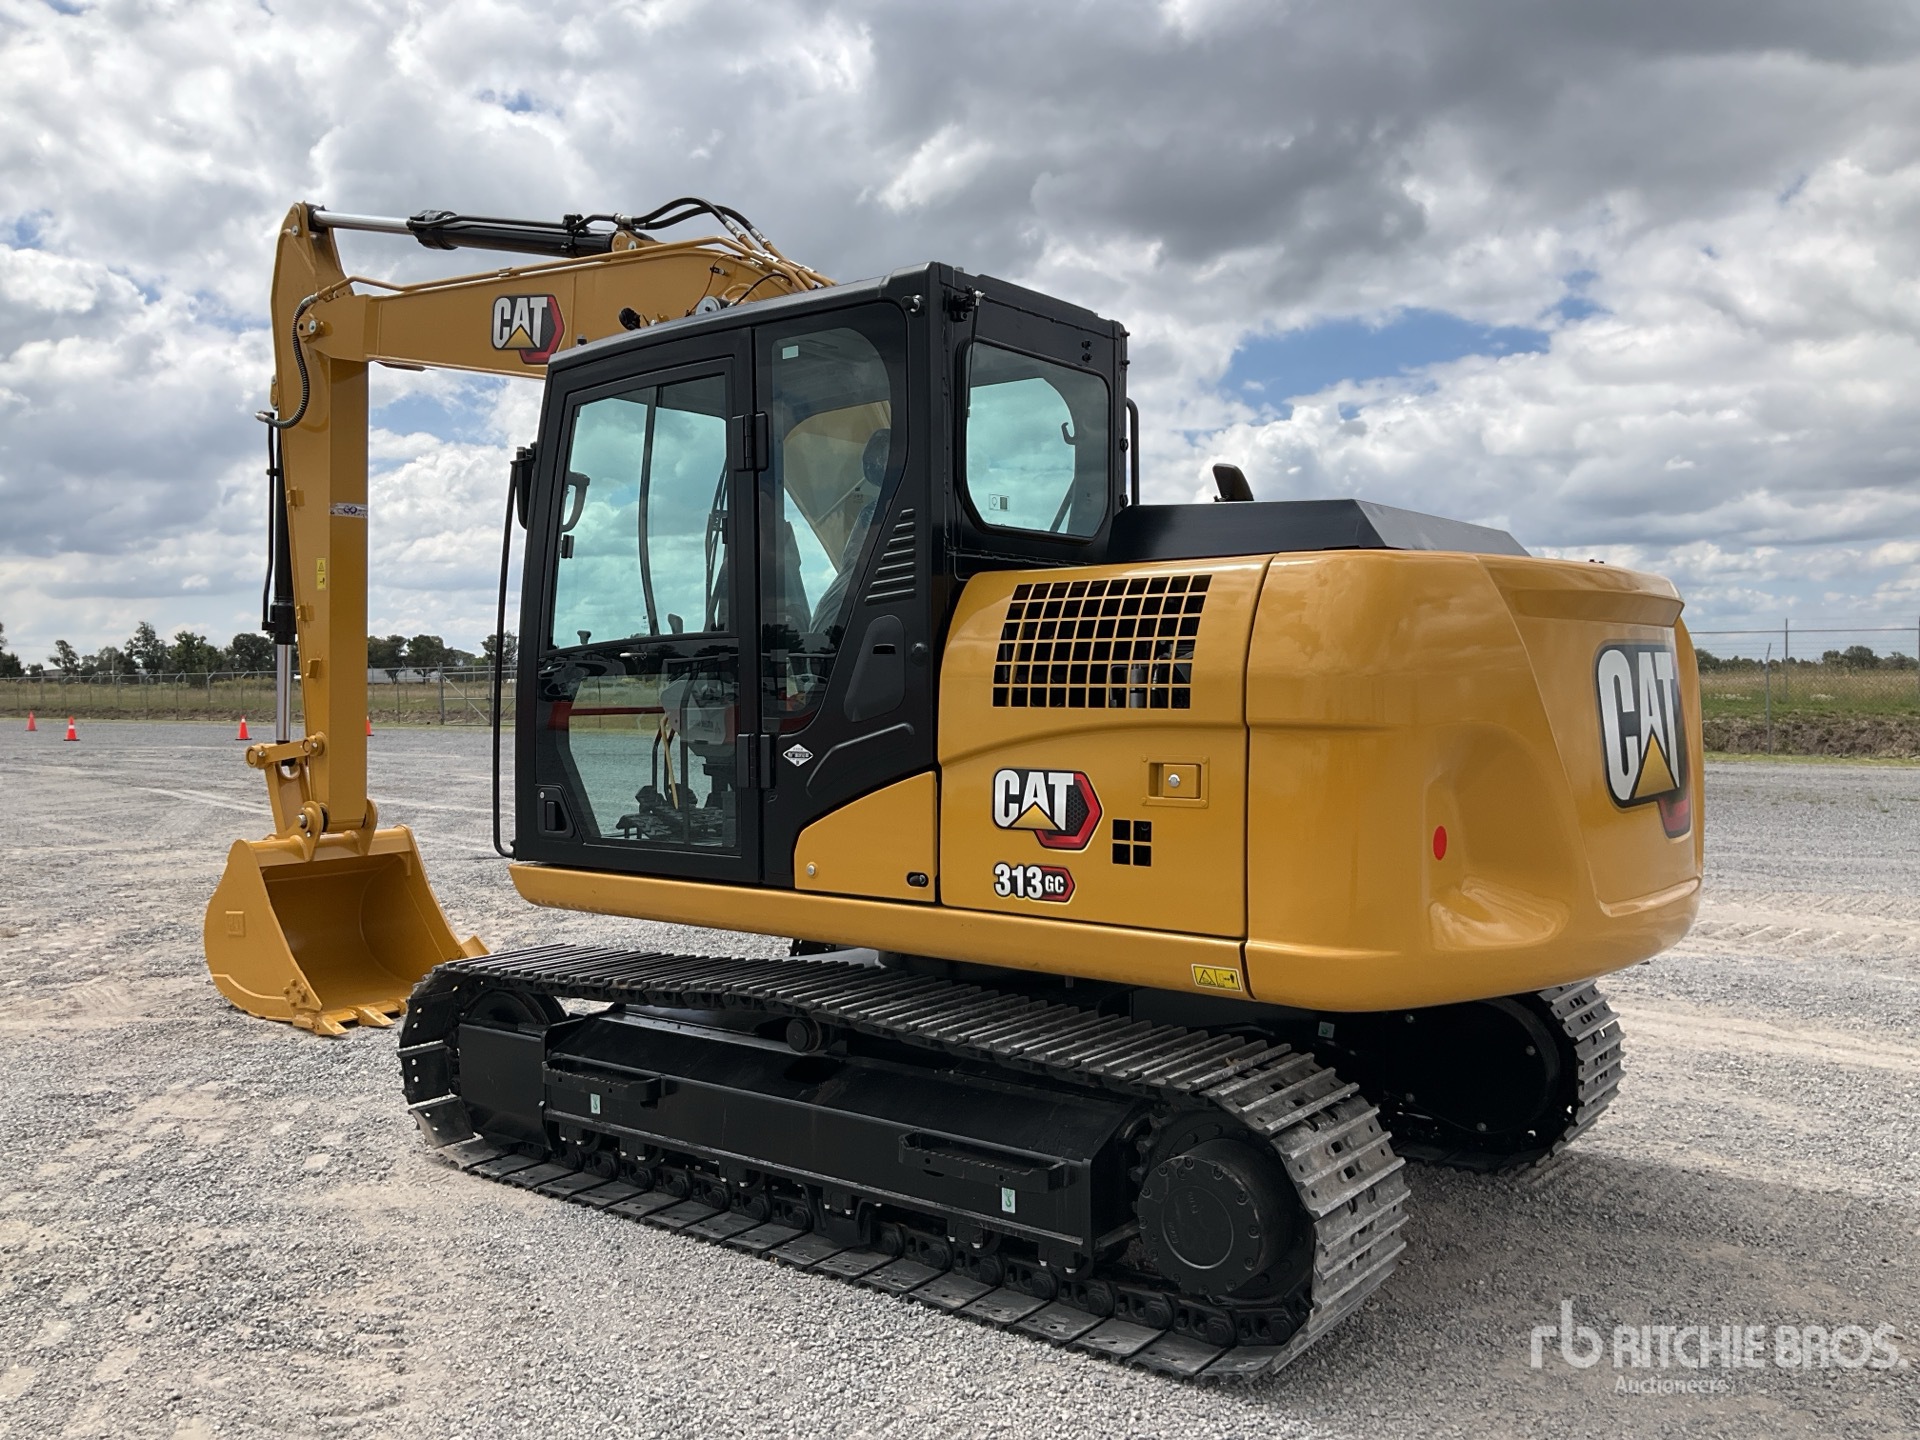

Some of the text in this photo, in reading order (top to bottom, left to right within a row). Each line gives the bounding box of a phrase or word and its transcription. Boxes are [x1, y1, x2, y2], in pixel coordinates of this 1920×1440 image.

[493, 296, 548, 349] CAT
[1598, 649, 1680, 800] CAT
[994, 769, 1074, 831] CAT
[994, 863, 1065, 898] 313 GC
